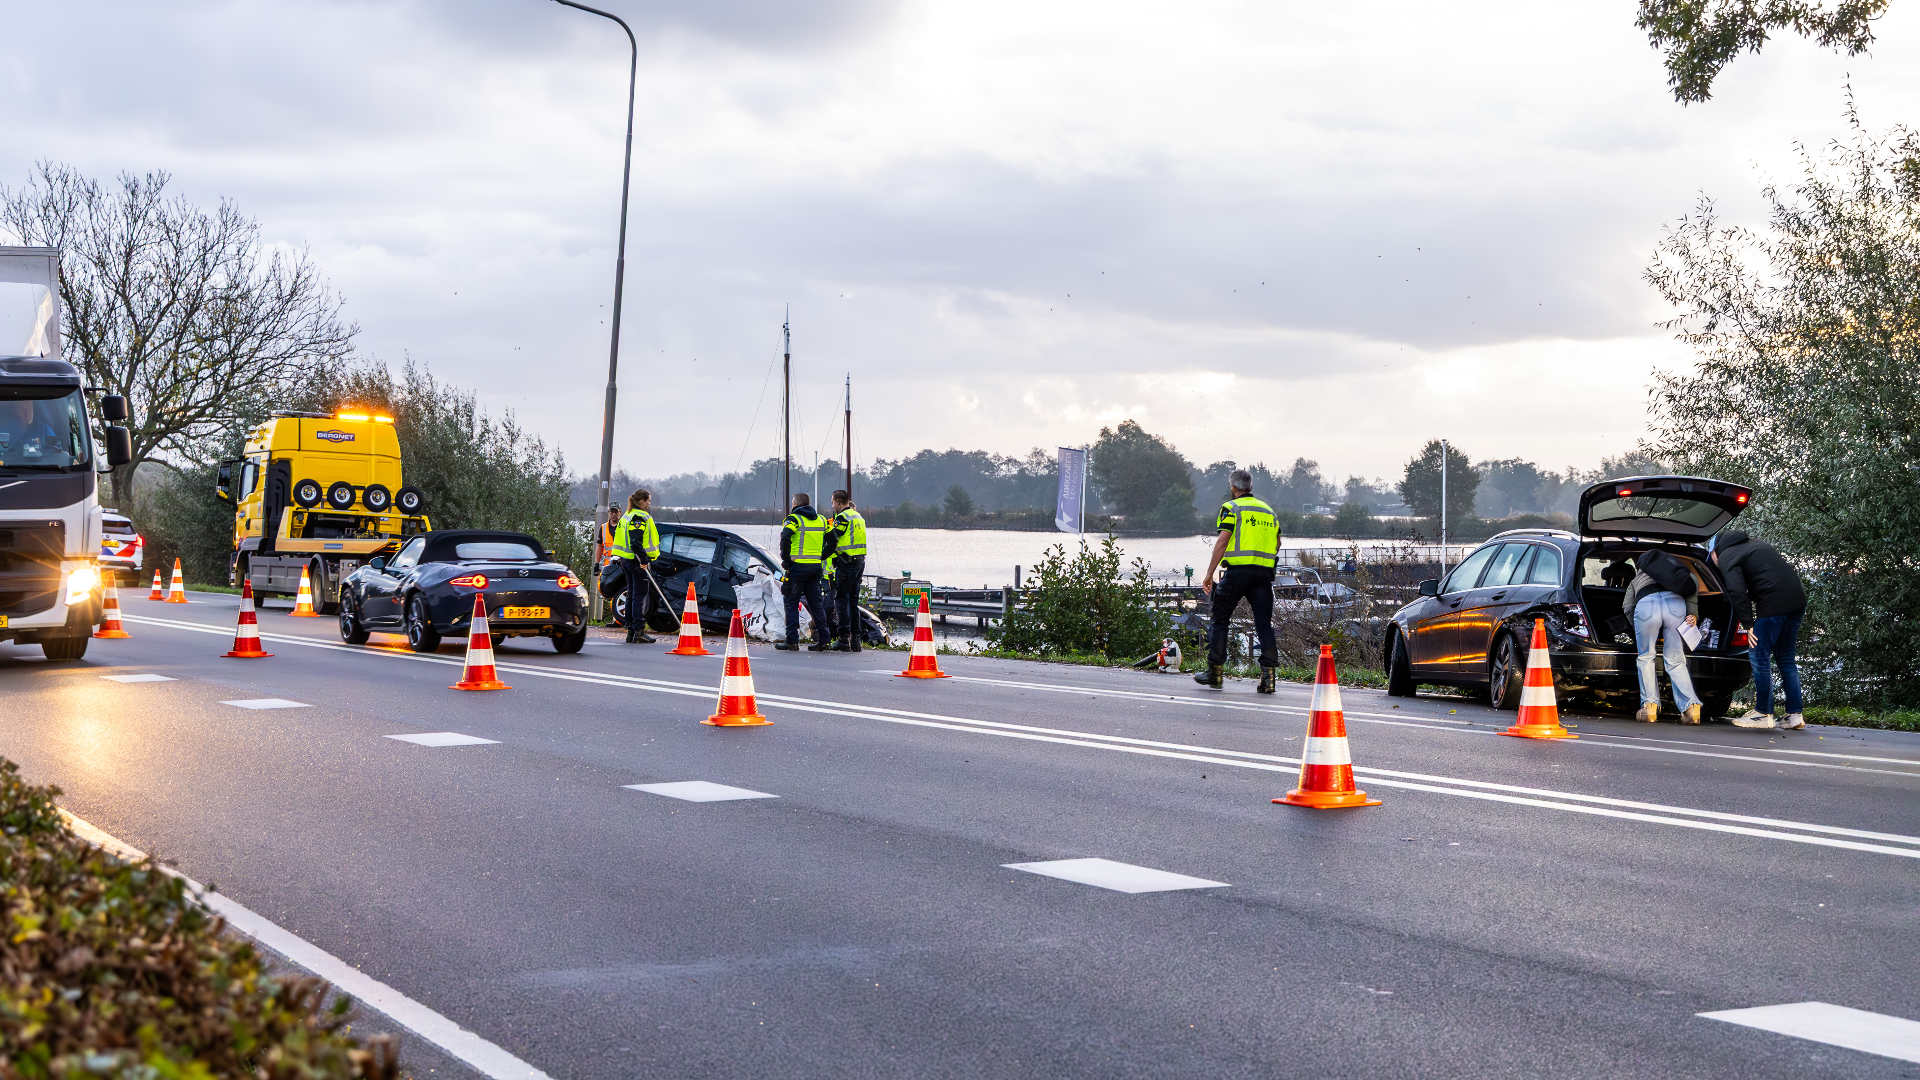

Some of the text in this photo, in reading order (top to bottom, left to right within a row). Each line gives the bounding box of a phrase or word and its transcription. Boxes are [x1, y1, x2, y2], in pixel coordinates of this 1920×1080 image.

[317, 432, 355, 440] BERGNET
[1245, 516, 1274, 528] POLITIE
[508, 608, 546, 617] P-193-FP
